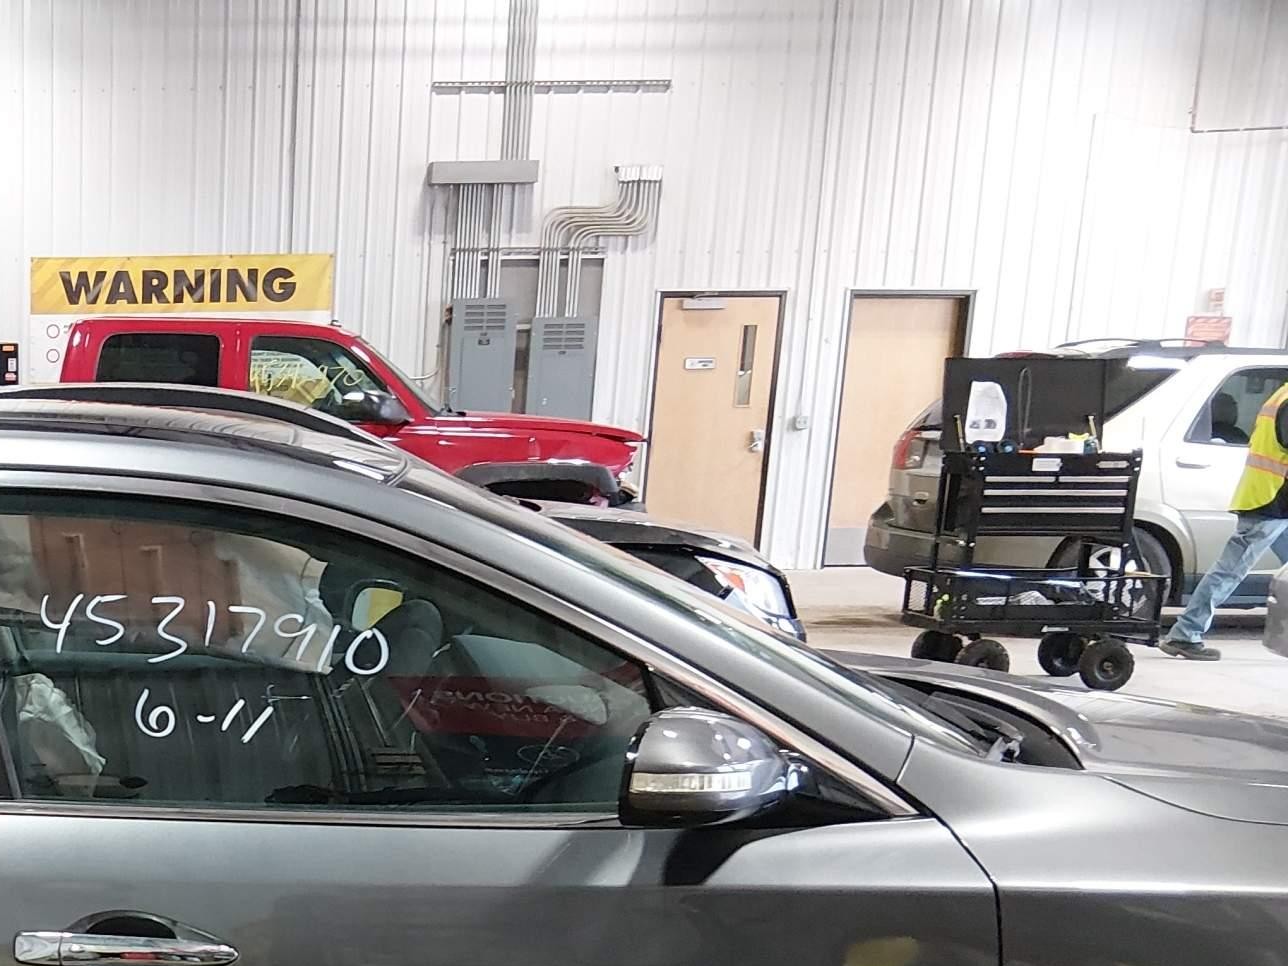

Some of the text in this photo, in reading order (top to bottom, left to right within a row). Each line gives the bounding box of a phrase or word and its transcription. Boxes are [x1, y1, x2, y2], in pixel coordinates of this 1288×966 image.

[59, 266, 297, 305] WARNING
[38, 593, 390, 676] 45317910
[134, 687, 274, 744] 6-11
